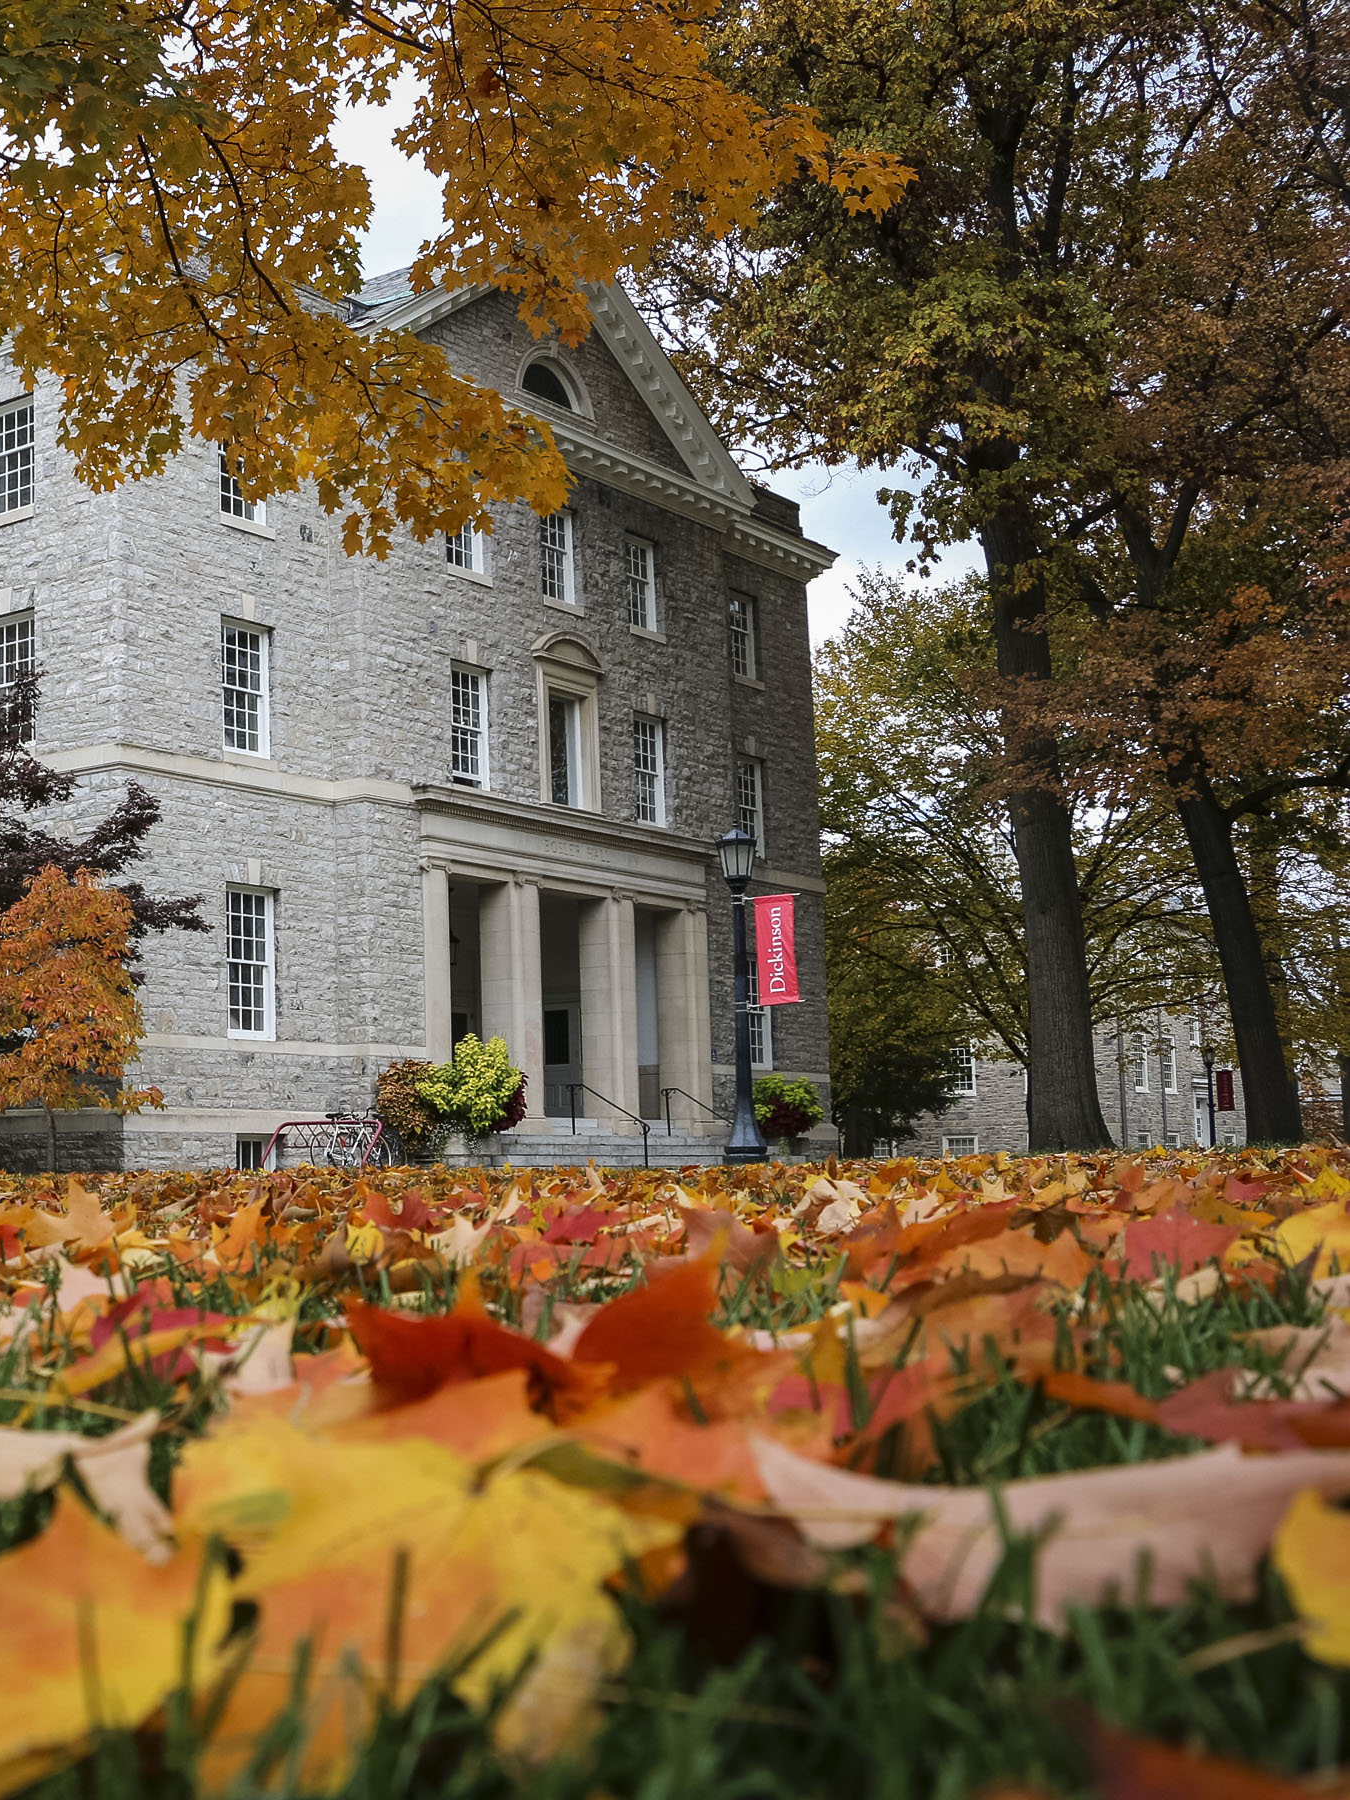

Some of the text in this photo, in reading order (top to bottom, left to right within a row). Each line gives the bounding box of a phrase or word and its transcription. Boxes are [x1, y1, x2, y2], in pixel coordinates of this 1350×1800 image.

[545, 839, 611, 863] BOSLER HALL
[767, 906, 786, 993] Dickinson
